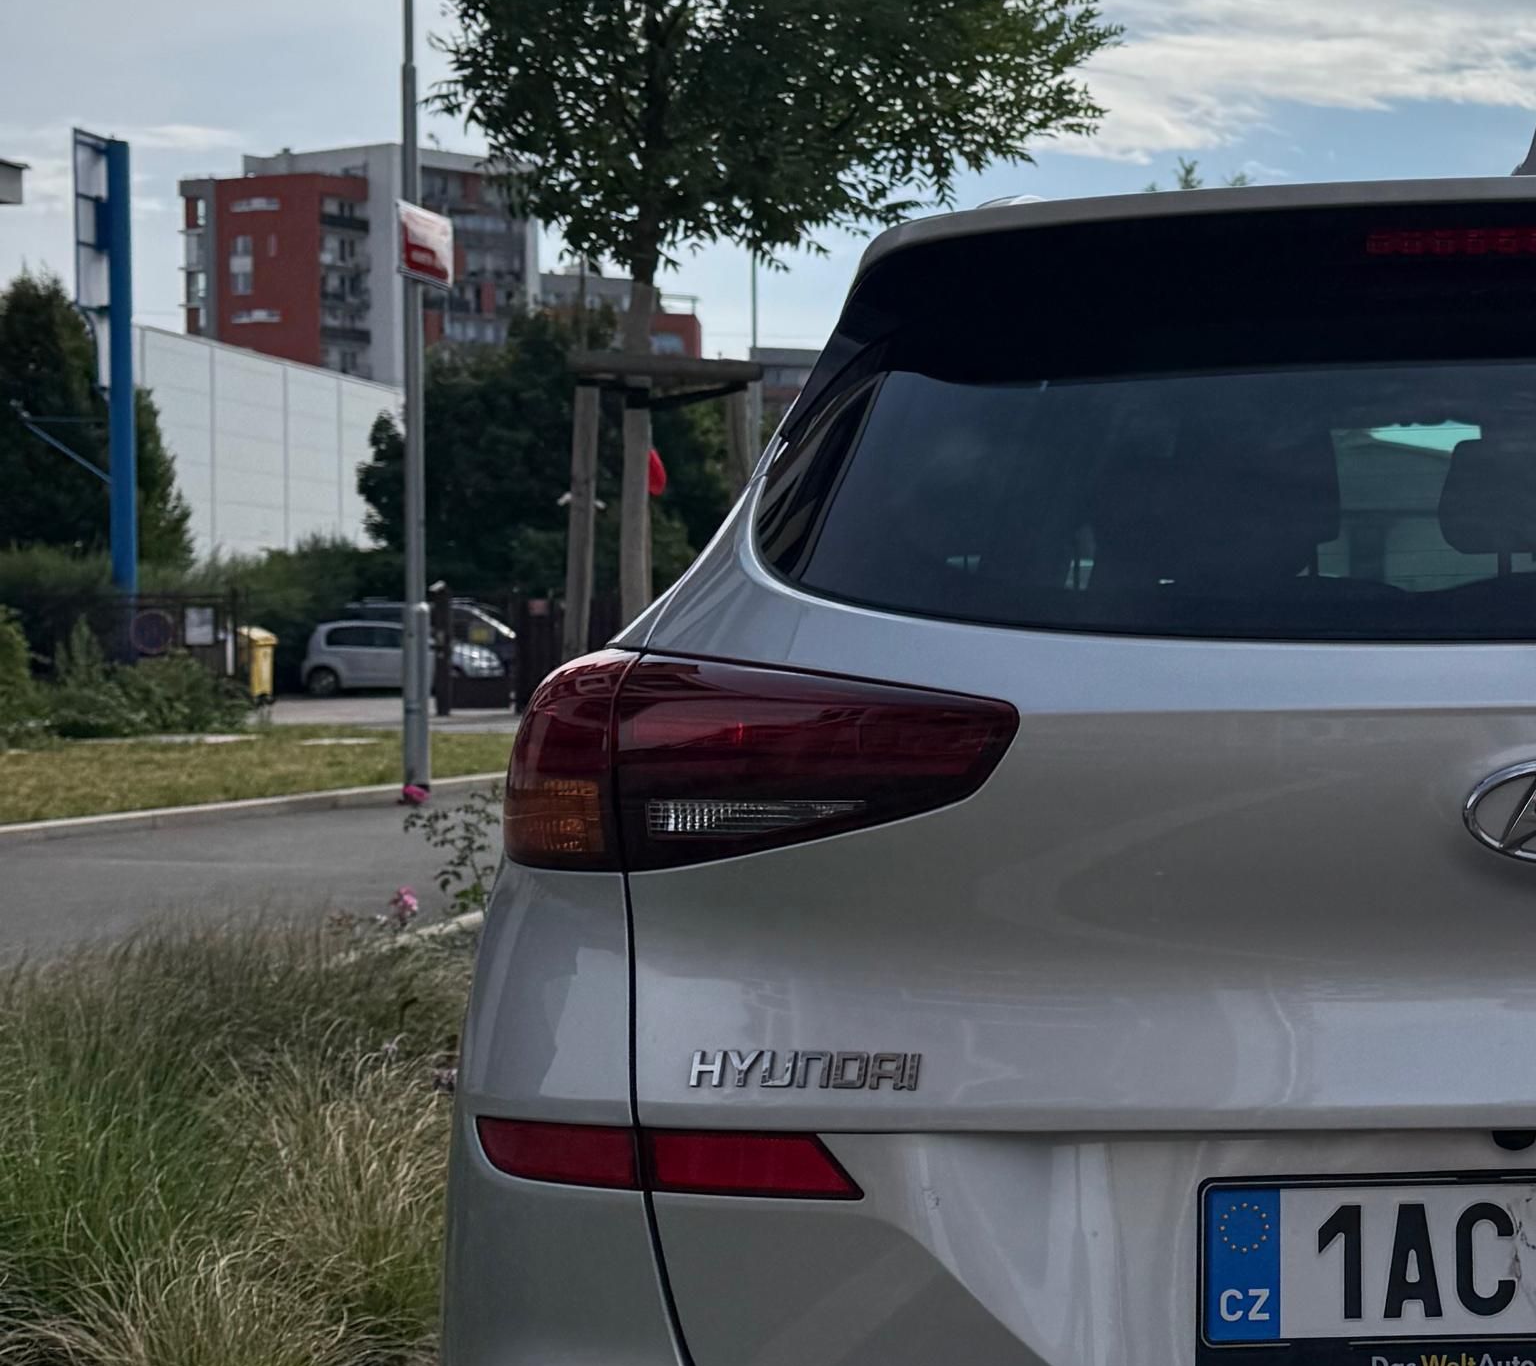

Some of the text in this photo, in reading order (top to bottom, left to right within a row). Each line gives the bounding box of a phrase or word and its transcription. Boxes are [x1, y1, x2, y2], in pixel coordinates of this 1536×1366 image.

[689, 1050, 921, 1091] HYUNDAI
[1318, 1202, 1517, 1319] 1AC
[1219, 1288, 1270, 1322] CZ
